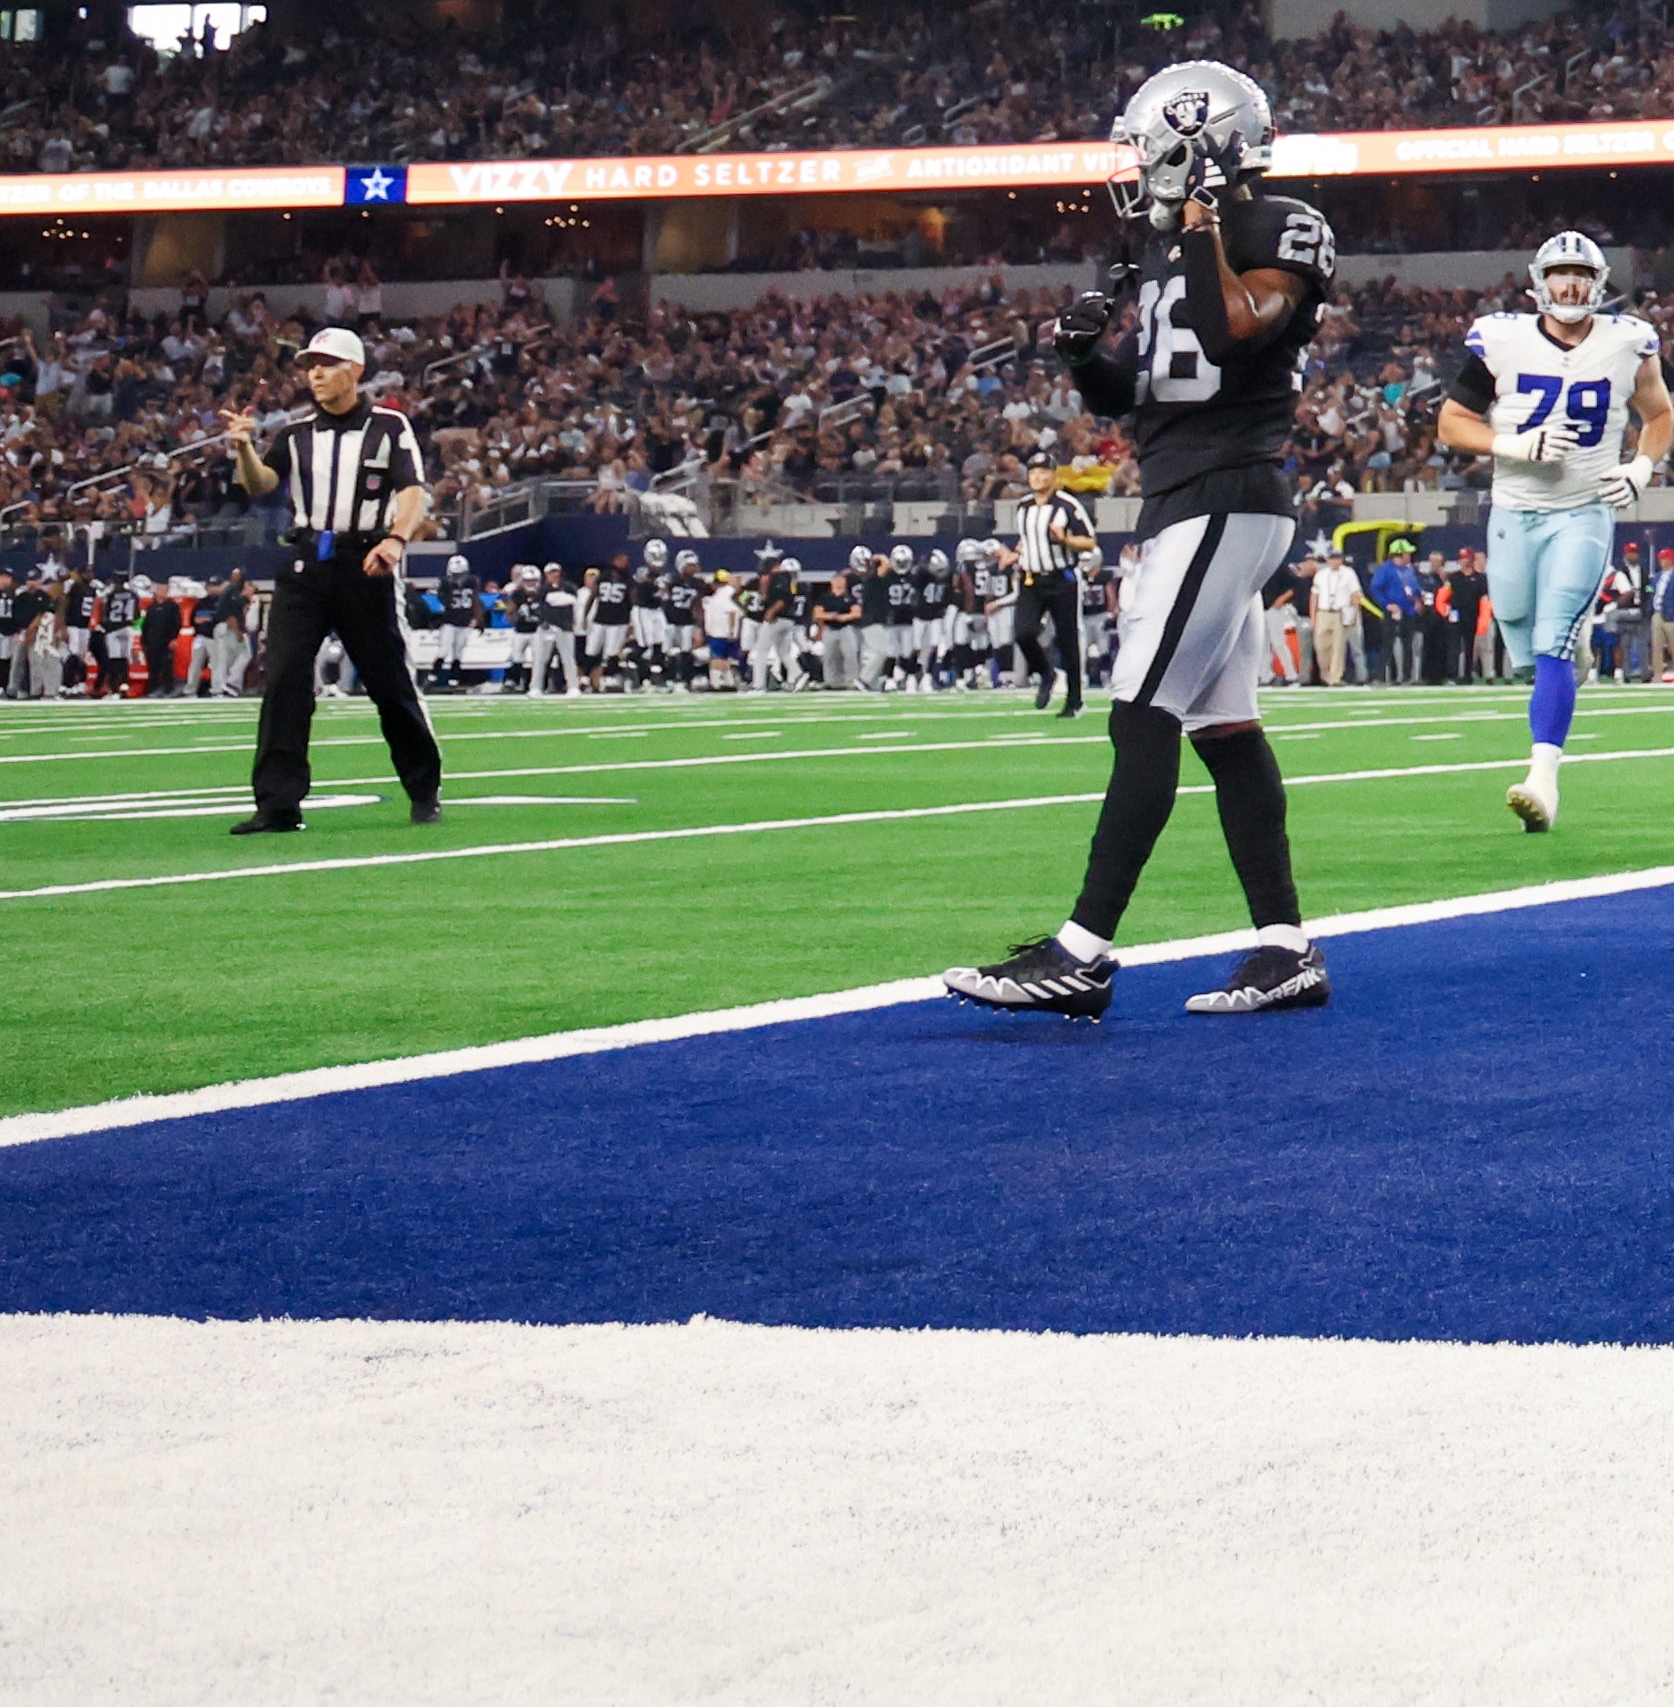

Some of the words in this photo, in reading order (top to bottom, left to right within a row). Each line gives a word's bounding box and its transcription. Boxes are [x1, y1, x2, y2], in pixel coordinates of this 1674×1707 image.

[450, 163, 572, 196] VIZZY
[586, 164, 679, 189] HARD
[694, 159, 840, 186] SELTZER
[906, 152, 1074, 178] ANTIOXIDANT
[1083, 151, 1141, 174] VITA
[58, 183, 90, 202] OF
[93, 181, 135, 200] THE
[143, 179, 223, 200] DALLAS
[227, 176, 332, 197] COWBOYS
[1517, 373, 1611, 447] 79
